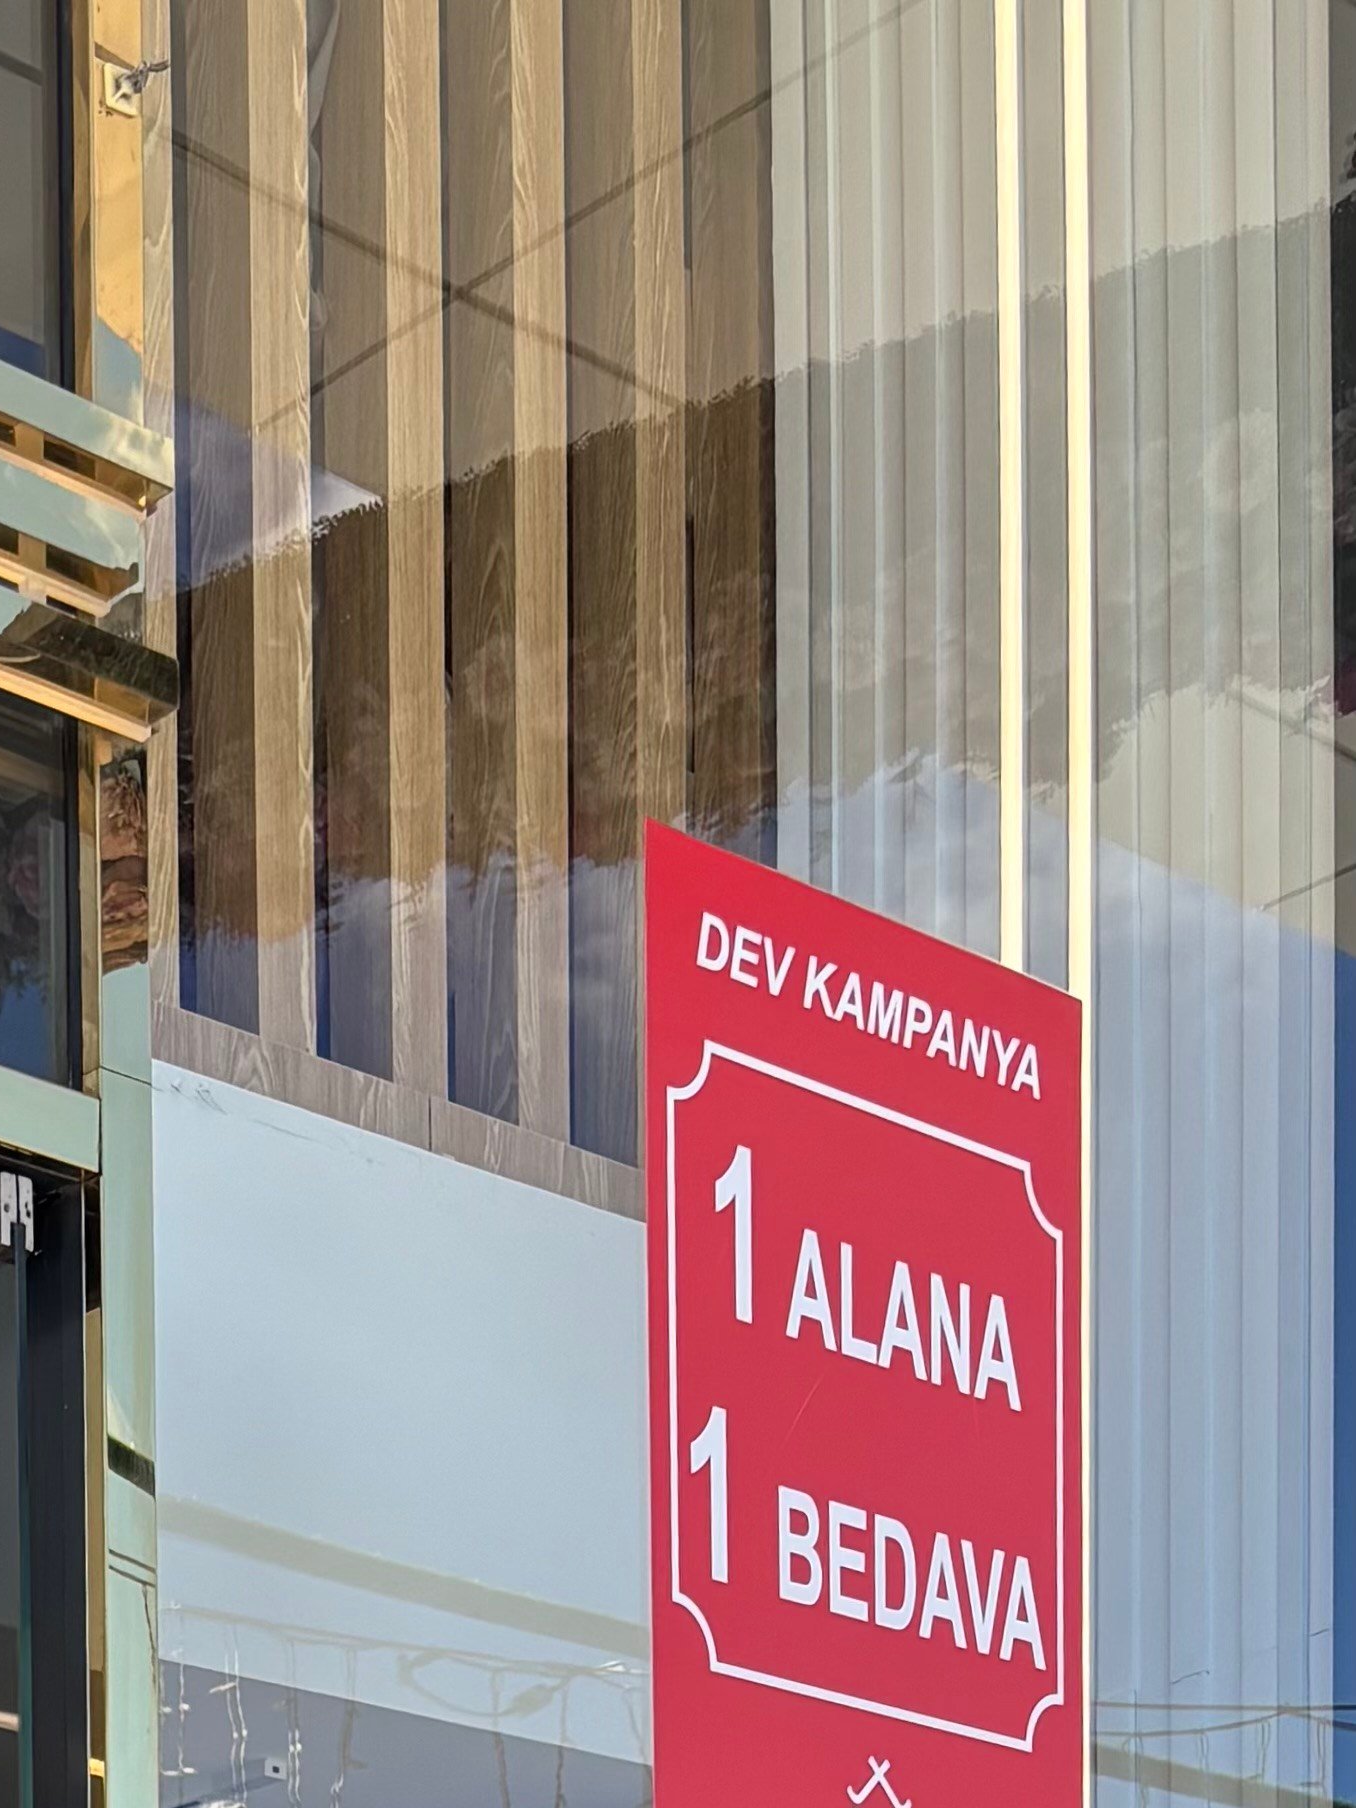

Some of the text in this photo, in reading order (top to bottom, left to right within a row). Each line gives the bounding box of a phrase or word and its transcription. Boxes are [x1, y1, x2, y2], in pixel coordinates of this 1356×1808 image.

[696, 912, 1042, 1099] DEV KAMPANYA
[714, 1145, 1021, 1412] 1 ALANA
[689, 1407, 1047, 1672] 1 BEDAVA
